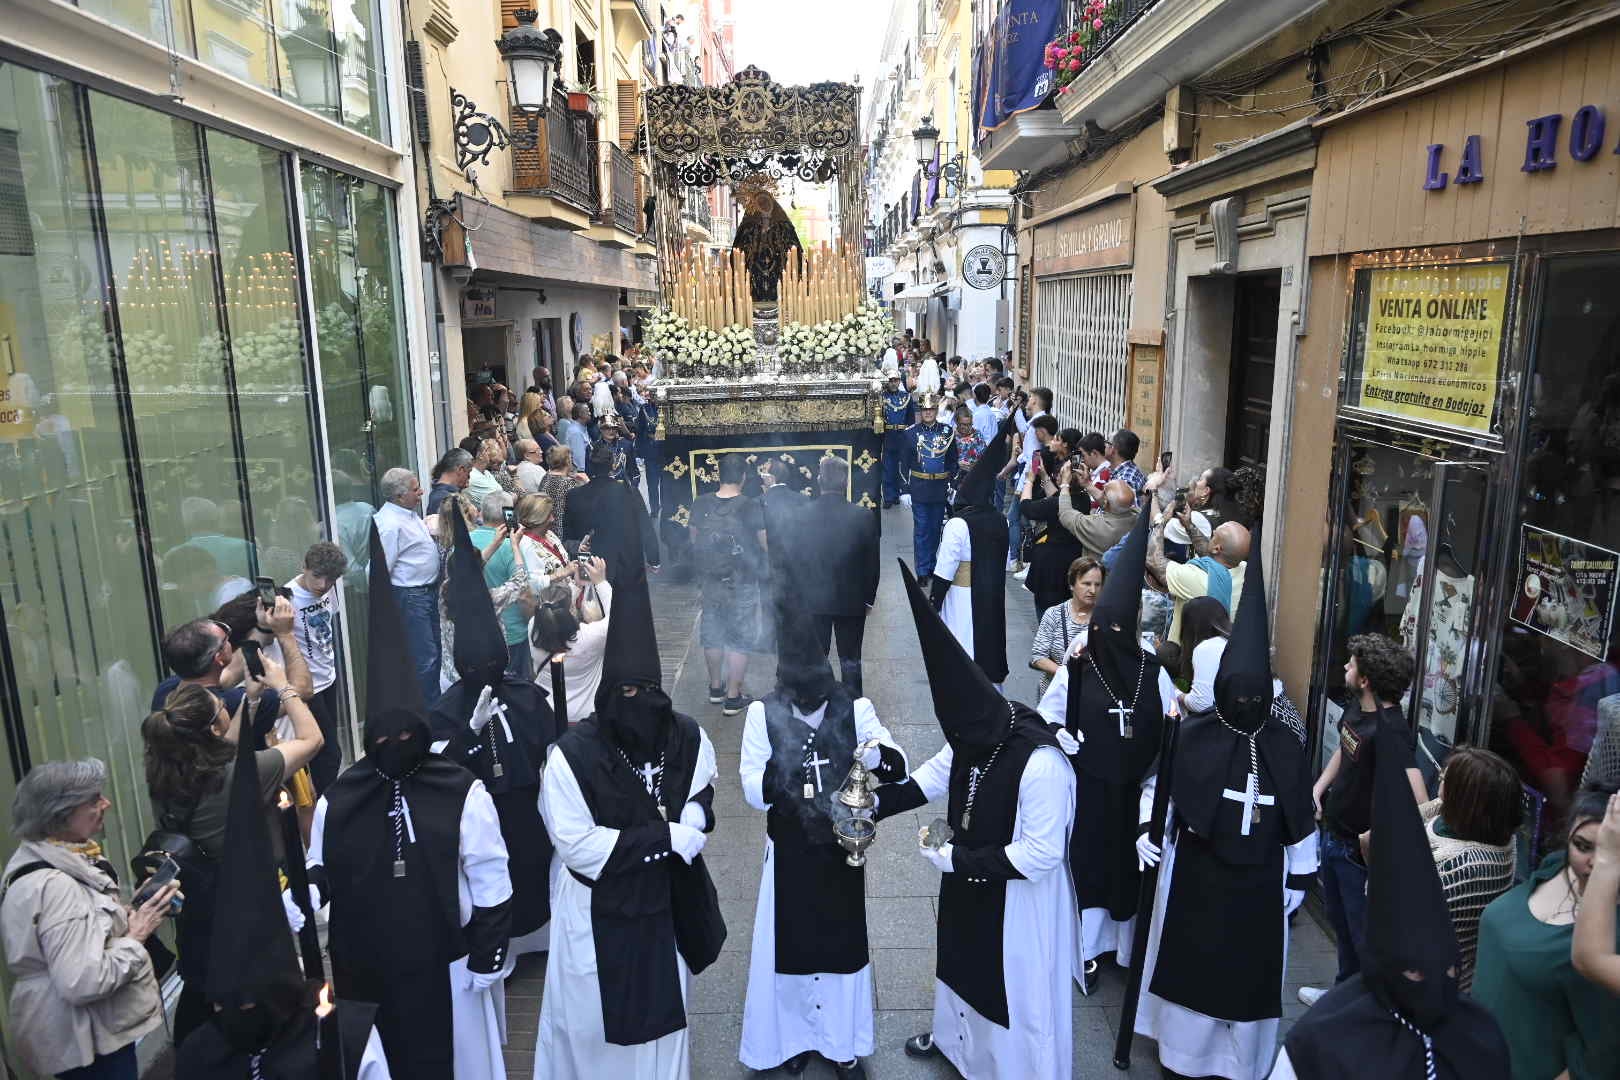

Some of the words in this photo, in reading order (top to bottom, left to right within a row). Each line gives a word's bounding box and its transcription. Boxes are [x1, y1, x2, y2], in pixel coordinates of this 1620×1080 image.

[1423, 135, 1483, 190] LA
[1520, 104, 1620, 173] HO
[1379, 299, 1421, 319] VENTA
[1427, 299, 1488, 320] ONLINE
[1365, 384, 1393, 401] Entrega
[1395, 391, 1431, 406] gratuita
[1432, 397, 1443, 408] en
[1445, 397, 1485, 416] Badajoz
